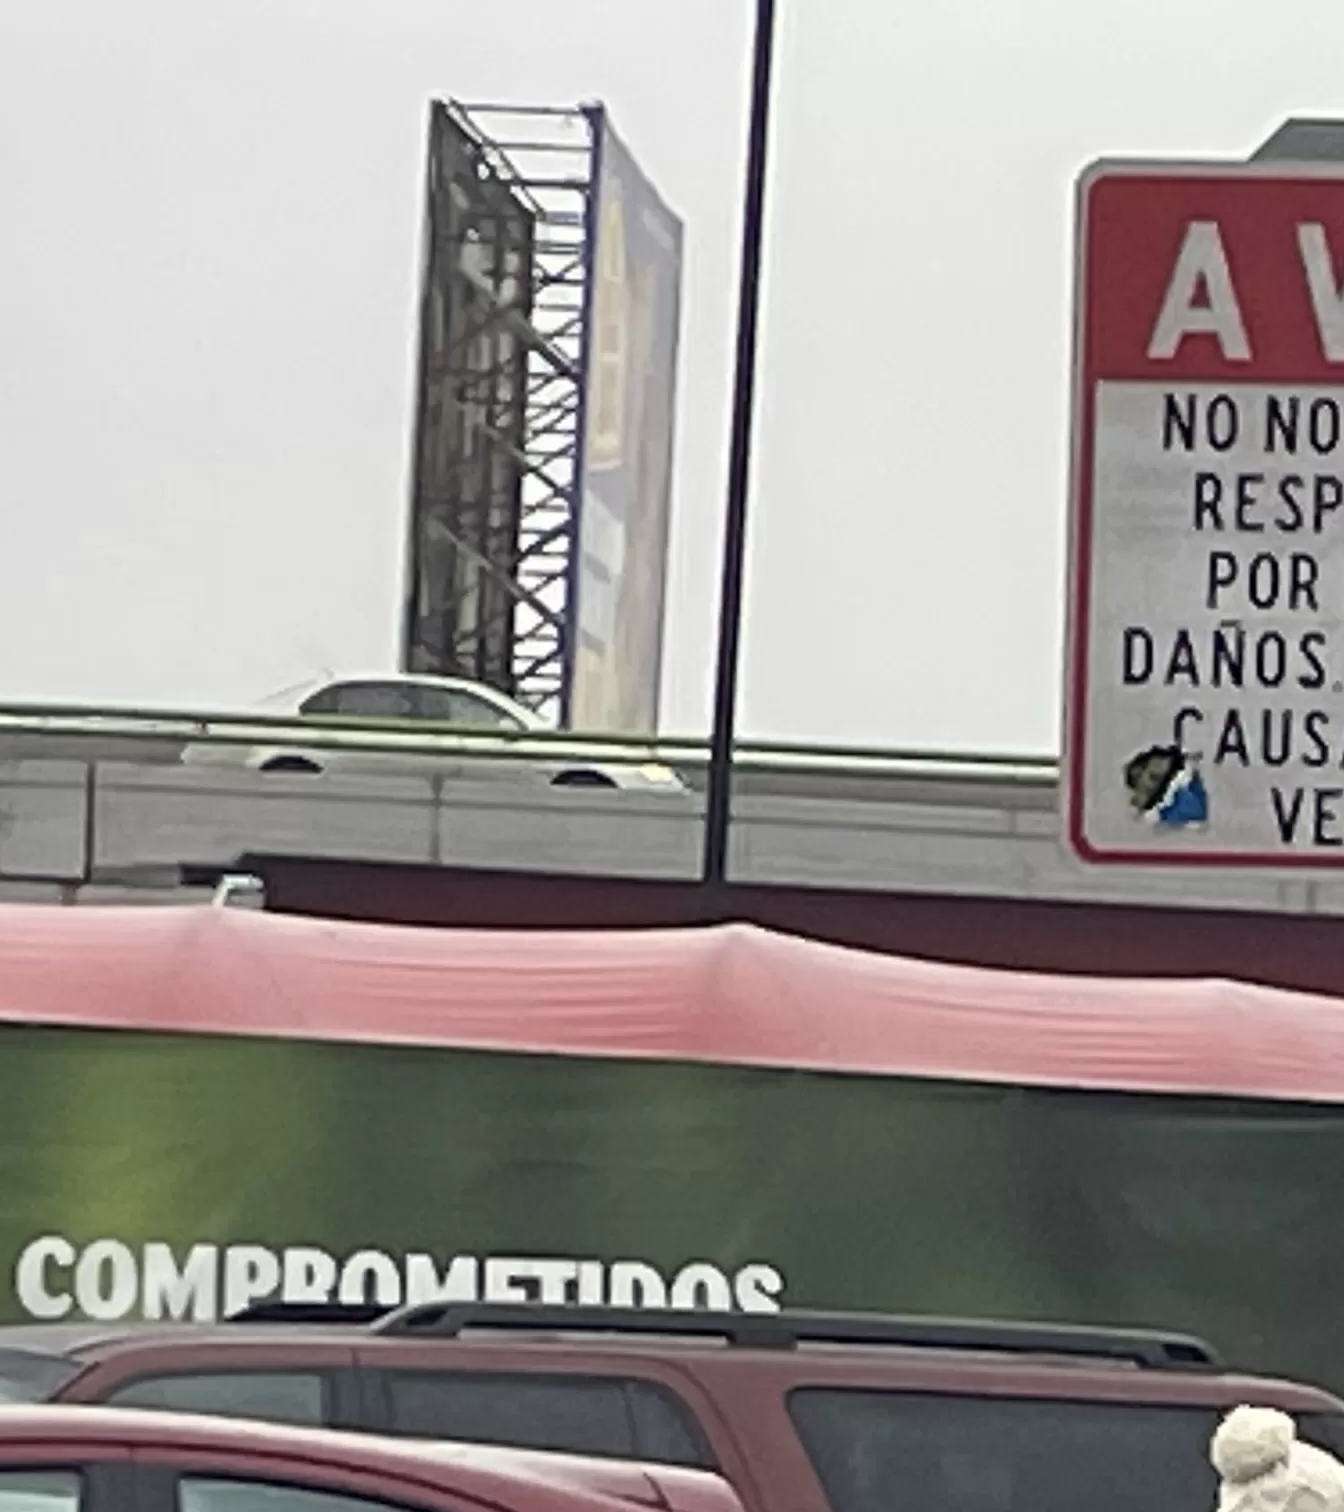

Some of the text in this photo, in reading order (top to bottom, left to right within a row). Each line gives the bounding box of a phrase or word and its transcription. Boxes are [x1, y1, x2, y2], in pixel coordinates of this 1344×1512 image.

[1161, 393, 1239, 453] NO
[1207, 552, 1319, 611] POR
[15, 1235, 785, 1322] COMPROMETIDOS
